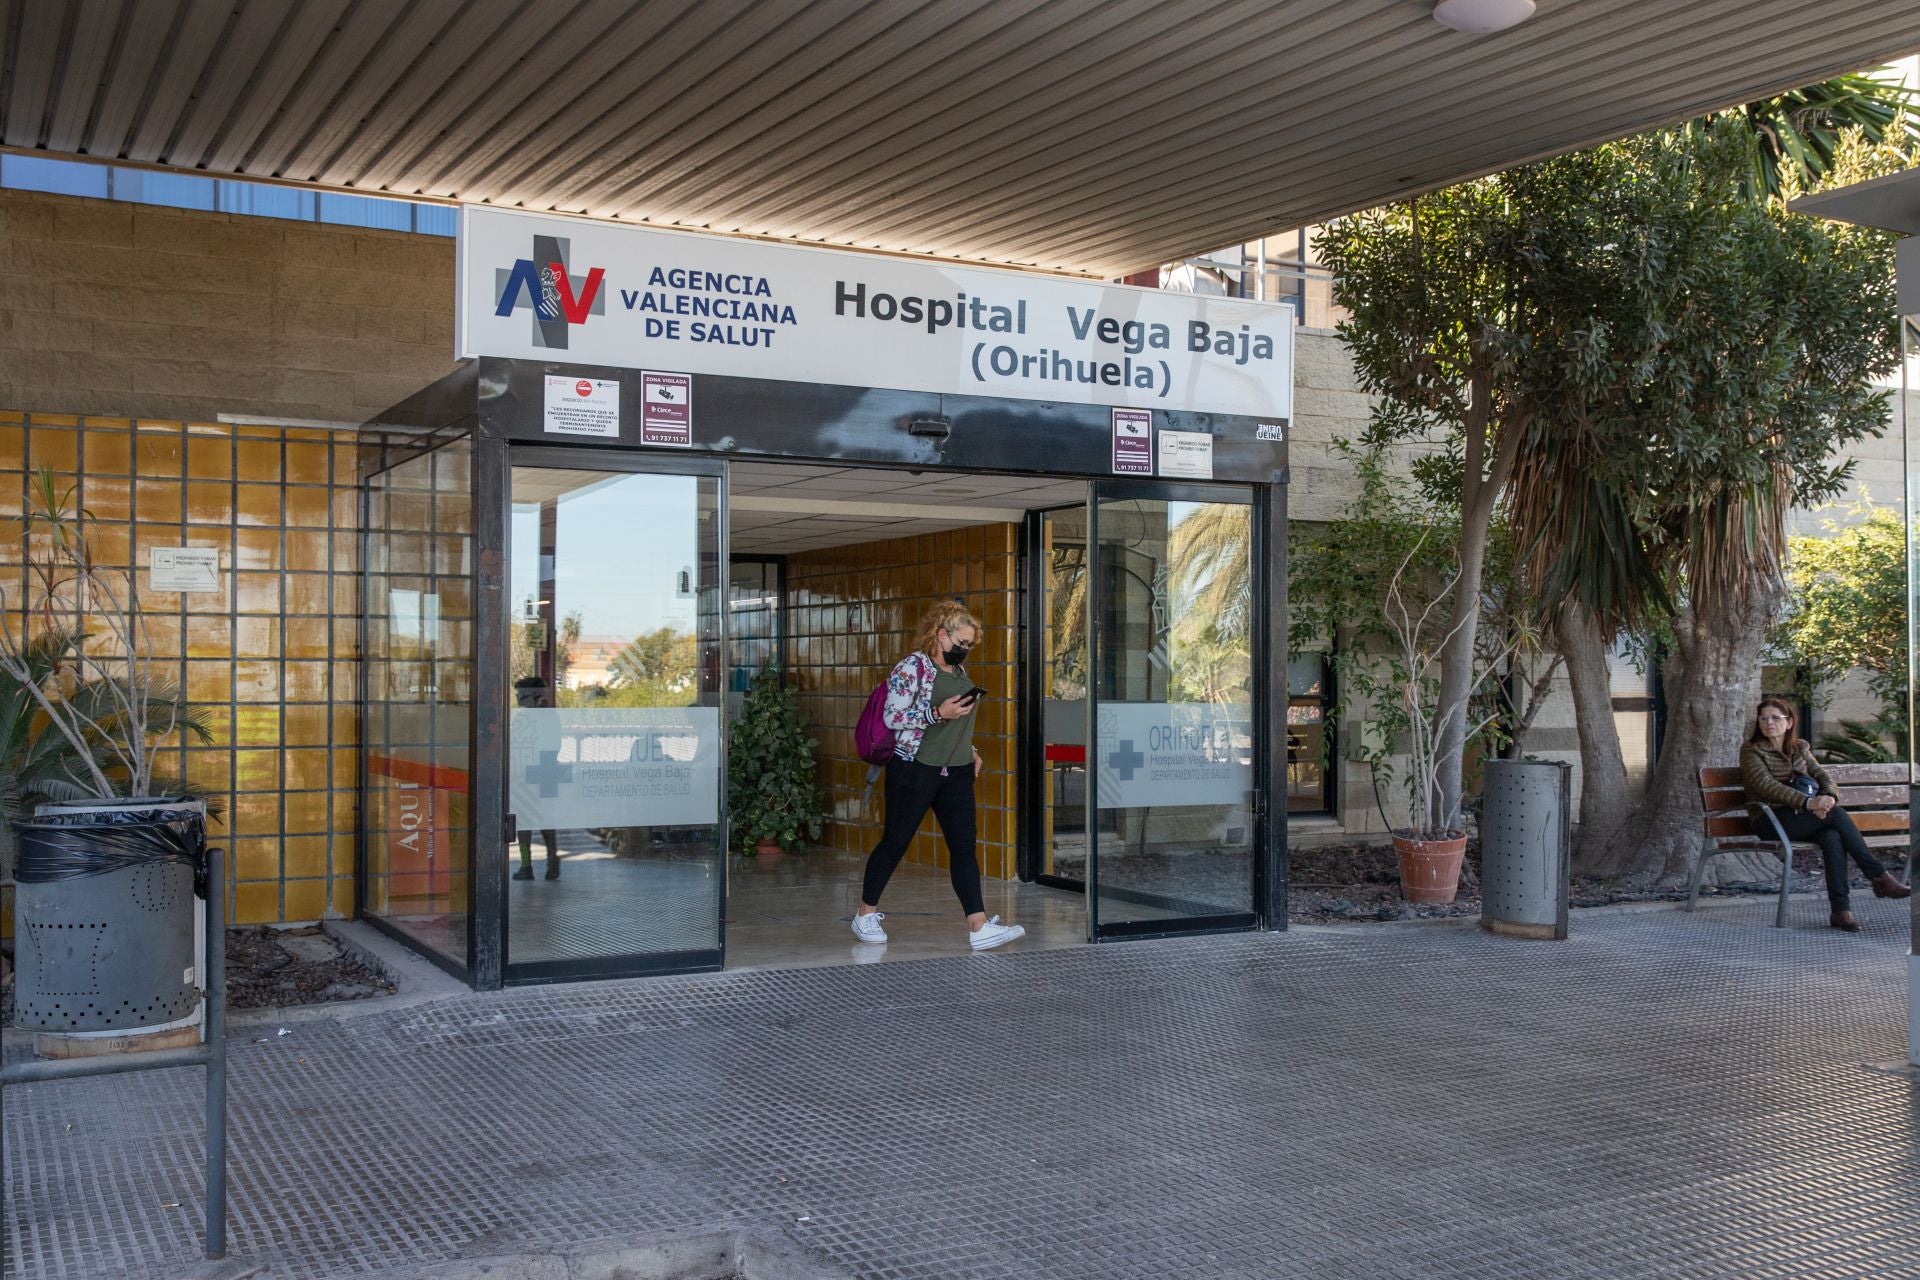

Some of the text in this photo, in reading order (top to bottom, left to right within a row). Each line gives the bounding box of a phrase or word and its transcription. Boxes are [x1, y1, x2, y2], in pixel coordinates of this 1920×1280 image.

[648, 266, 772, 298] AGENCIA
[620, 289, 798, 326] VALENCIANA
[834, 279, 1275, 365] Hospital Vega Baja
[645, 317, 775, 348] DE SALUT
[971, 341, 1172, 398] (Orihuela)
[582, 764, 690, 782] Hospital Vega Baja
[1150, 752, 1185, 767] Hospital
[1151, 769, 1200, 781] DEPARTAMENTO
[582, 783, 690, 798] DEPARTAMENTO DE SALUD
[396, 781, 422, 853] AQUÍ
